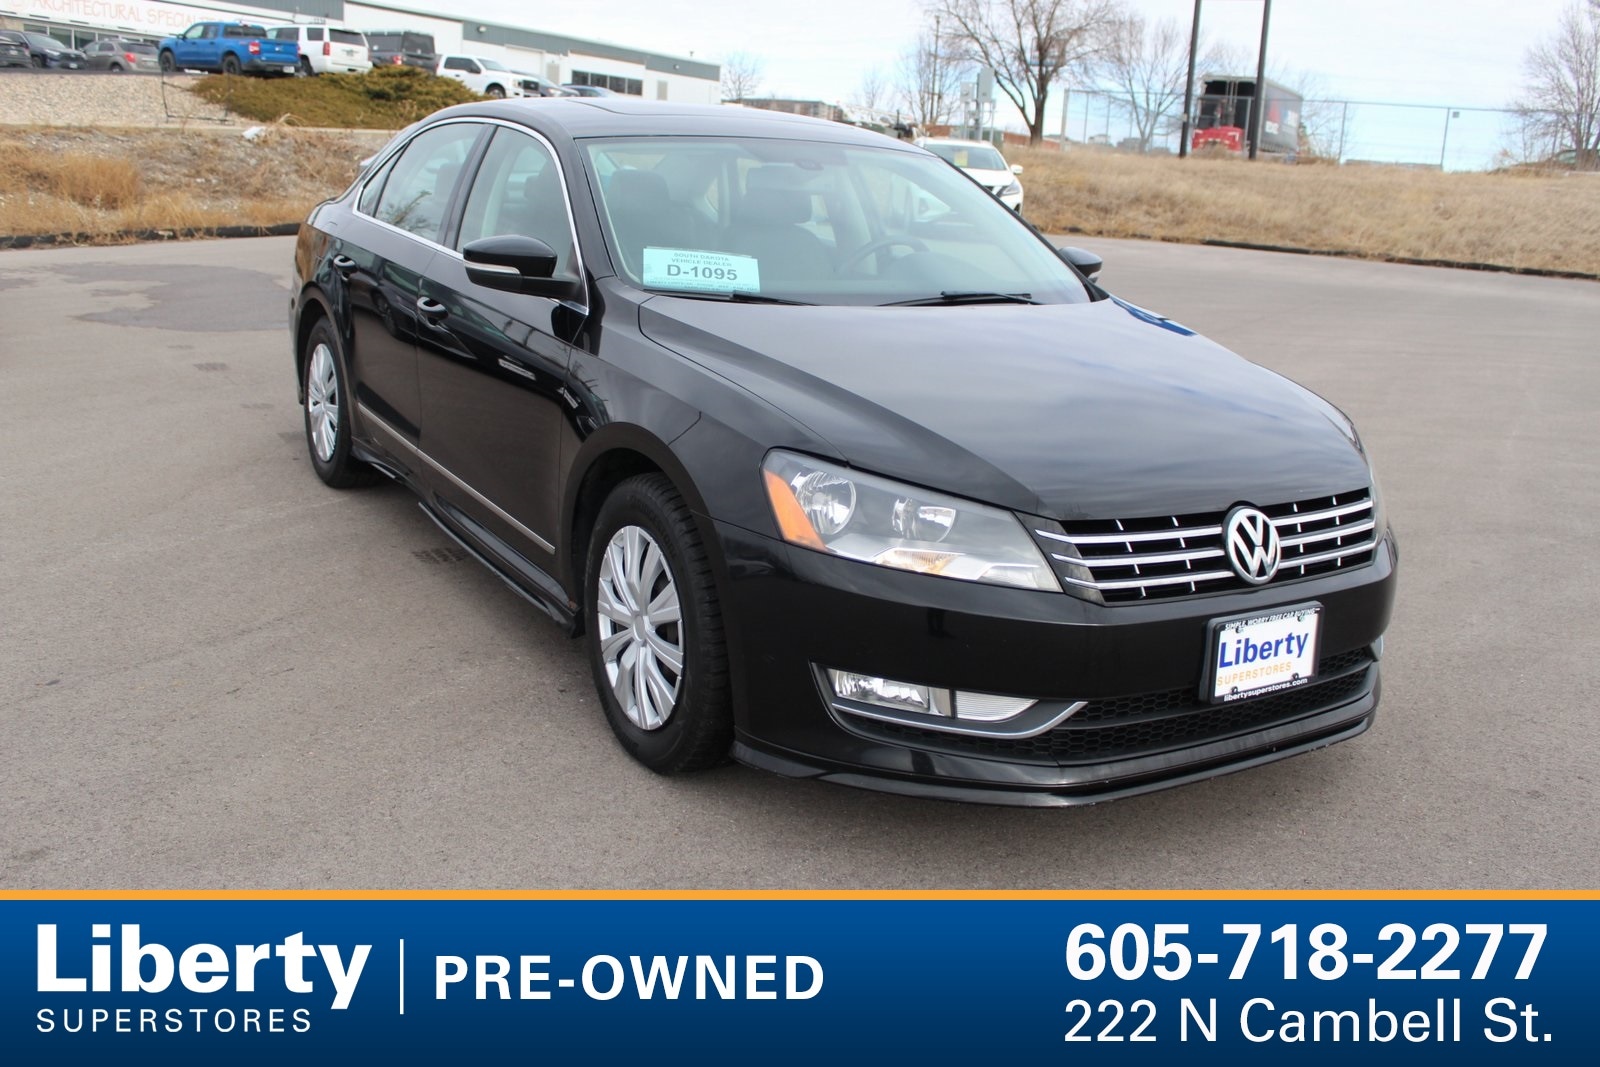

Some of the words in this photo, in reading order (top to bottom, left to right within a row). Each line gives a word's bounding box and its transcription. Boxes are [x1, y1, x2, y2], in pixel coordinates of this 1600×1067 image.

[32, 0, 144, 22] ARCHITECTURAL
[671, 257, 701, 265] VEHICLE
[703, 260, 733, 268] DEALER
[673, 252, 699, 260] SOUTH
[700, 254, 729, 262] DAKOTA
[666, 264, 738, 281] D-1095
[1229, 509, 1279, 582] VW
[1247, 615, 1269, 627] WORRY
[1283, 611, 1295, 620] CAR
[1218, 631, 1310, 669] Liberty
[1216, 661, 1293, 687] SUPERSTORES
[1223, 677, 1308, 702] libertysuperstores.com
